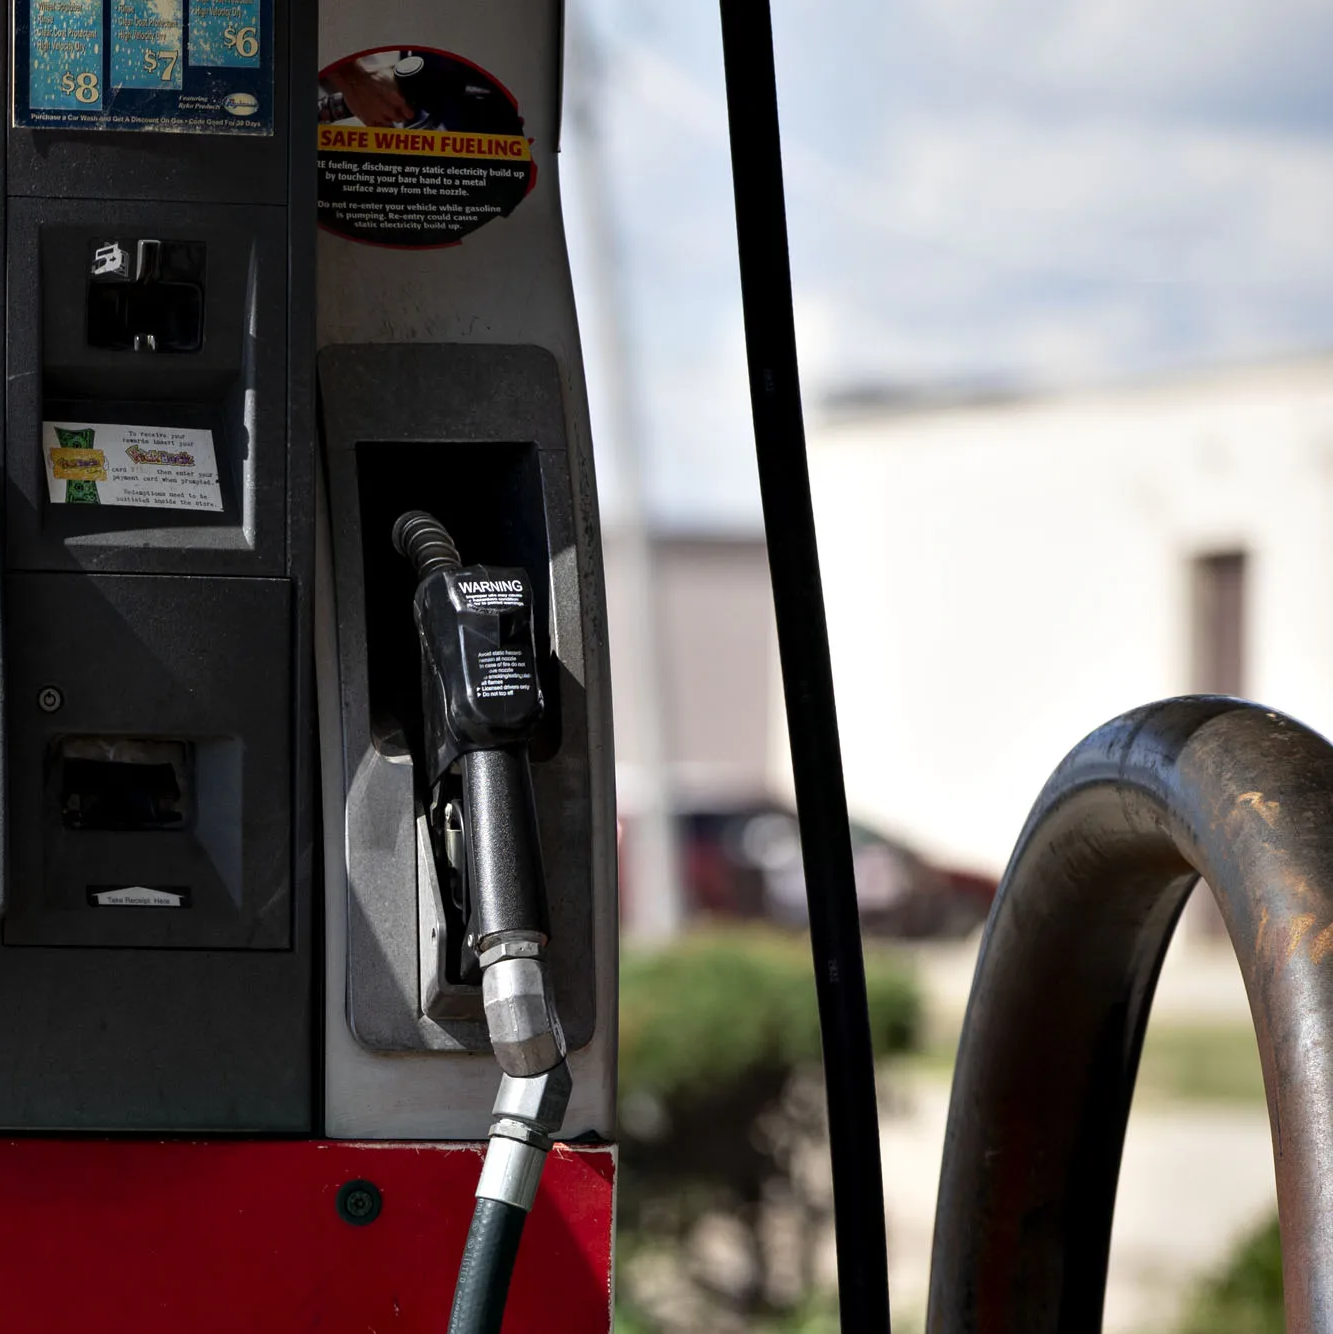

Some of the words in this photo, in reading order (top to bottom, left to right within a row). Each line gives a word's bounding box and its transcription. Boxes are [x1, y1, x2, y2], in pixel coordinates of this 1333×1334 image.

[224, 25, 259, 57] $6
[144, 48, 179, 82] $7
[61, 71, 100, 104] $8
[321, 130, 368, 148] SAFE
[375, 132, 435, 152] WHEN
[441, 136, 522, 157] FUELING
[325, 171, 336, 182] by
[338, 173, 374, 183] touching
[377, 176, 395, 184] your
[398, 175, 417, 183] bare
[420, 176, 441, 184] hand
[362, 162, 402, 174] discharge
[405, 167, 420, 175] any
[422, 166, 445, 174] static
[447, 167, 487, 177] electricity
[490, 168, 511, 177] build
[514, 171, 524, 179] up
[343, 184, 373, 192] surface
[377, 187, 398, 195] away
[401, 185, 420, 194] from
[440, 188, 469, 196] nozzle.
[346, 212, 386, 221] pumping.
[389, 213, 424, 221] Re-entry
[385, 204, 404, 212] your
[465, 205, 501, 214] gasoline
[458, 580, 523, 593] WARNING
